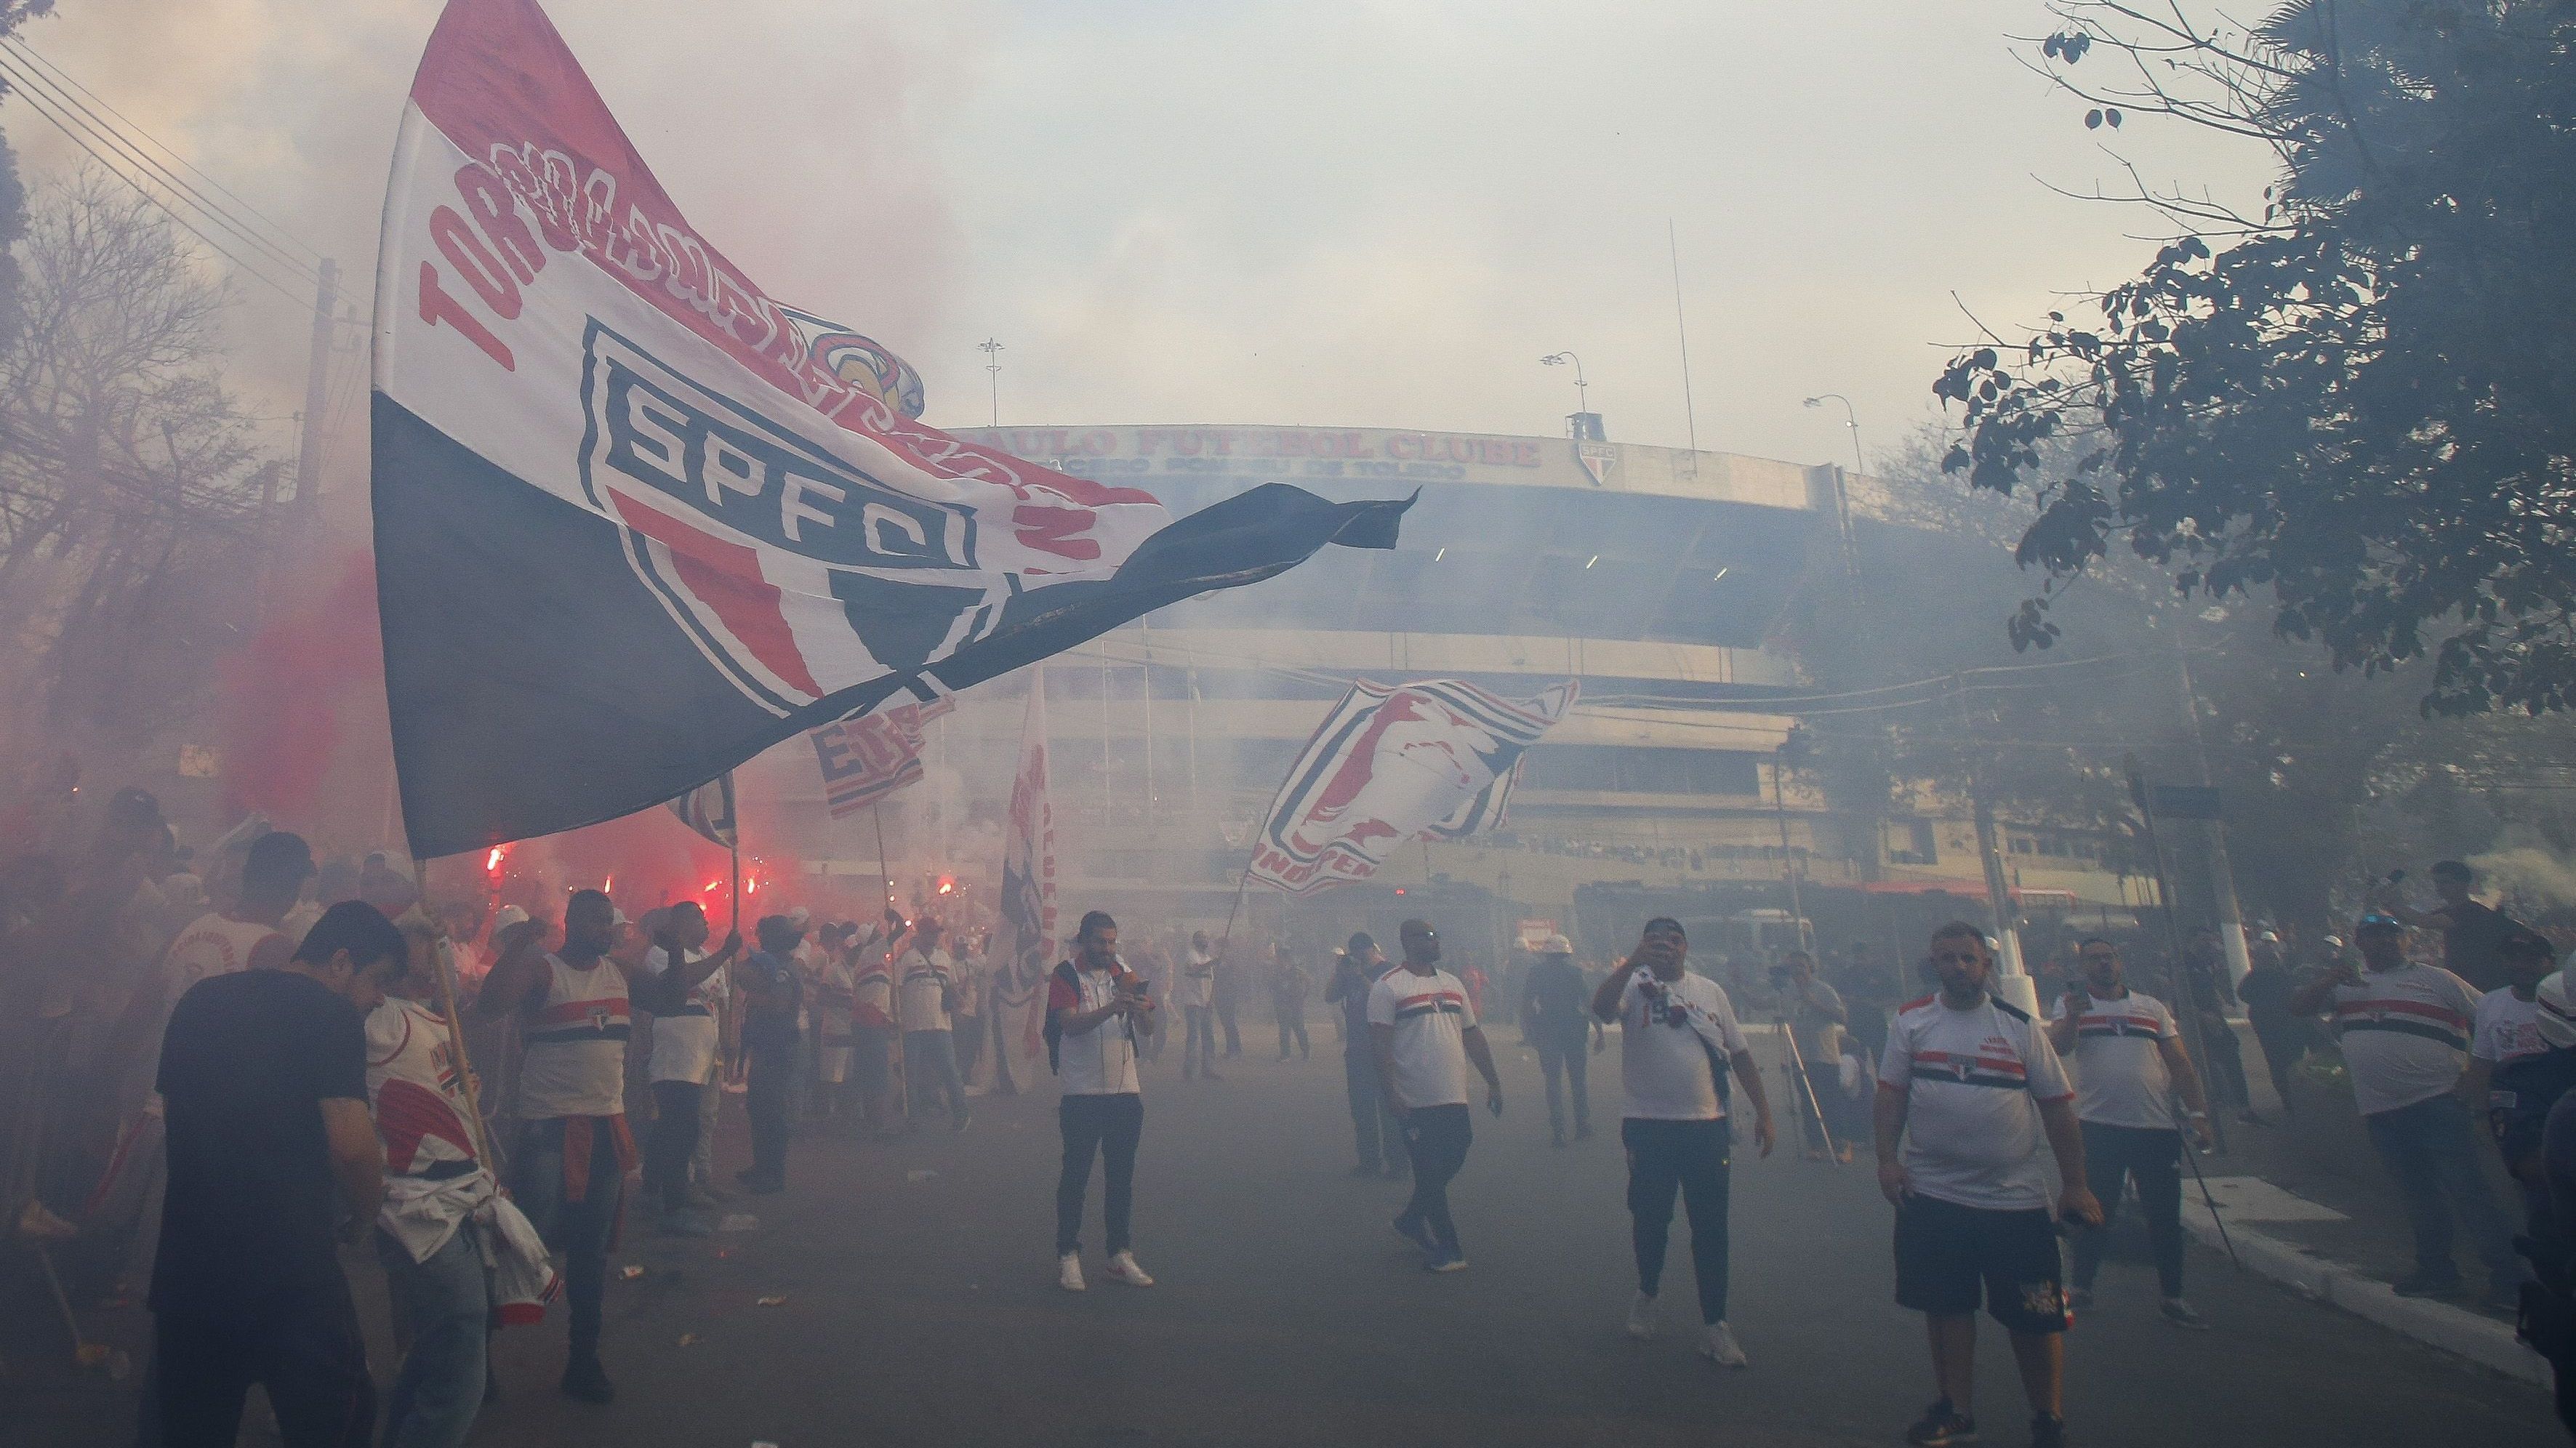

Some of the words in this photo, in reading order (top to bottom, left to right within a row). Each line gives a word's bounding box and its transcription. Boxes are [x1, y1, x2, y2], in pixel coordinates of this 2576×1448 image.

[1136, 428, 1374, 458] FUTEBOL
[1384, 433, 1543, 467] CLUBE
[1581, 445, 1614, 458] SPFC
